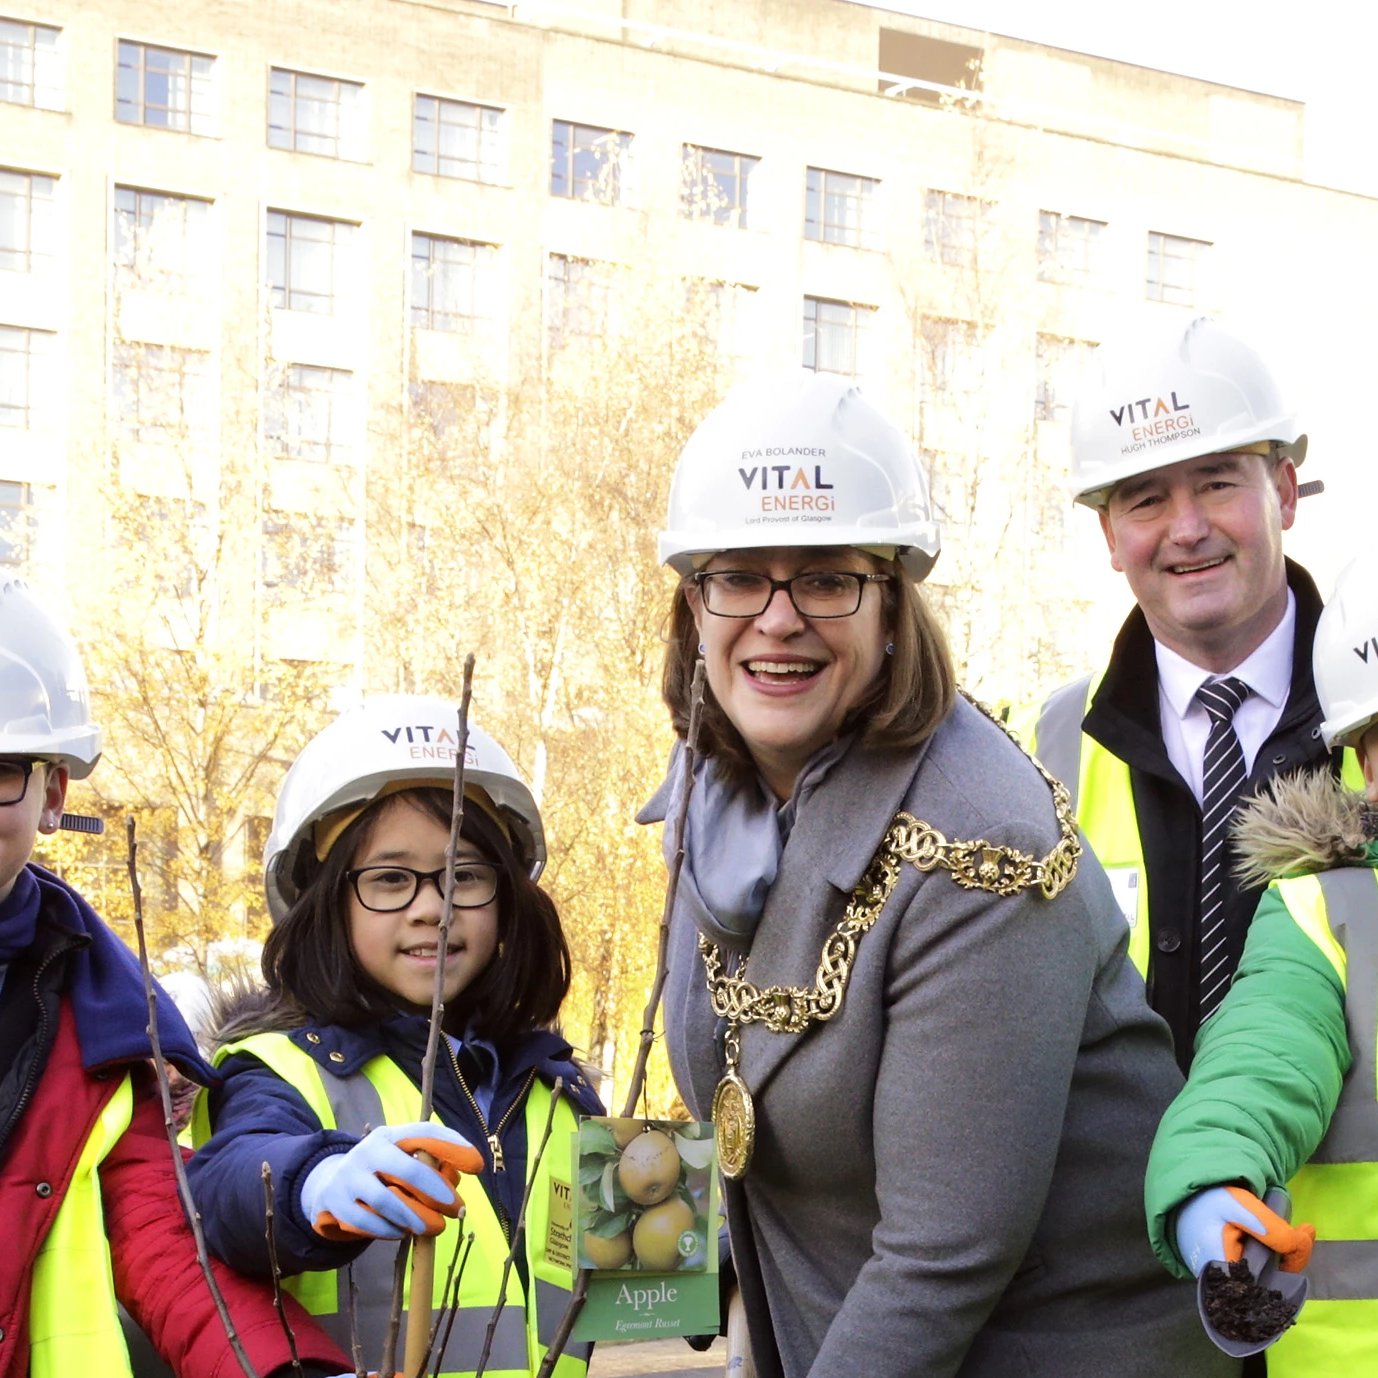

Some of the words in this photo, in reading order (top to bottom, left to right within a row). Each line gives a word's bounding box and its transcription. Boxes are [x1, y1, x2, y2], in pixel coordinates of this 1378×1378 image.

[1110, 392, 1190, 426] VITAL
[1132, 413, 1194, 441] ENERGi
[1121, 442, 1146, 454] HUGH
[1147, 427, 1201, 447] THOMPSON
[742, 449, 763, 460] EVA
[765, 447, 826, 457] BOLANDER
[738, 465, 834, 490] VITAL
[762, 495, 835, 511] ENERGi
[762, 515, 790, 523] Provost
[801, 514, 832, 523] Glasgow
[553, 1182, 572, 1201] VIT
[615, 1281, 679, 1311] Apple
[615, 1319, 653, 1333] Egremont
[655, 1317, 681, 1328] Russet
